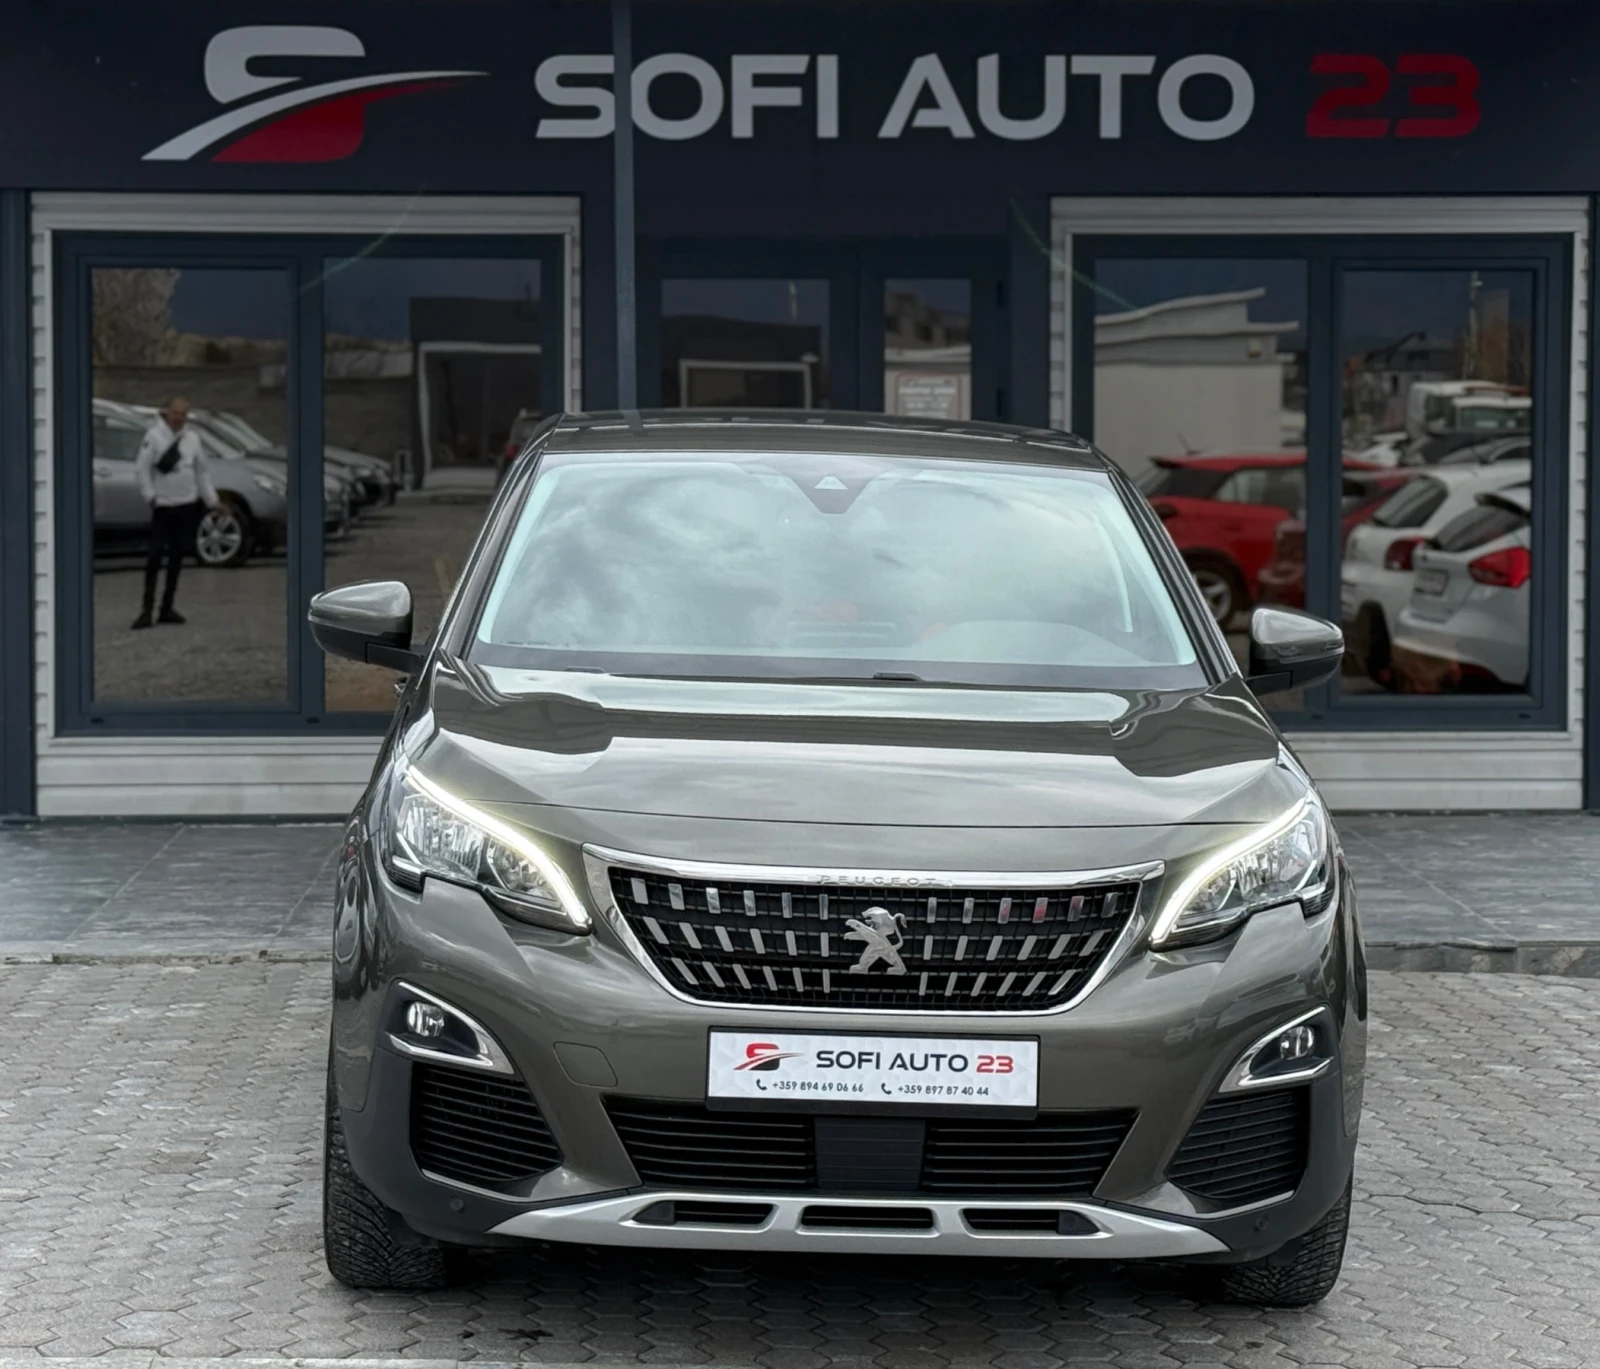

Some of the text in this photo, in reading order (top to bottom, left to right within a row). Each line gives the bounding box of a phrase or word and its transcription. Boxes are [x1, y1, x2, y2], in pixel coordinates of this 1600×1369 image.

[535, 53, 1481, 140] SOFI AUTO 23
[819, 875, 936, 887] PEUGEOT
[816, 1050, 1014, 1074] SOFI AUTO 23
[772, 1081, 864, 1093] +359 894 69 06 66
[898, 1084, 989, 1096] +359 897 87 40 44
